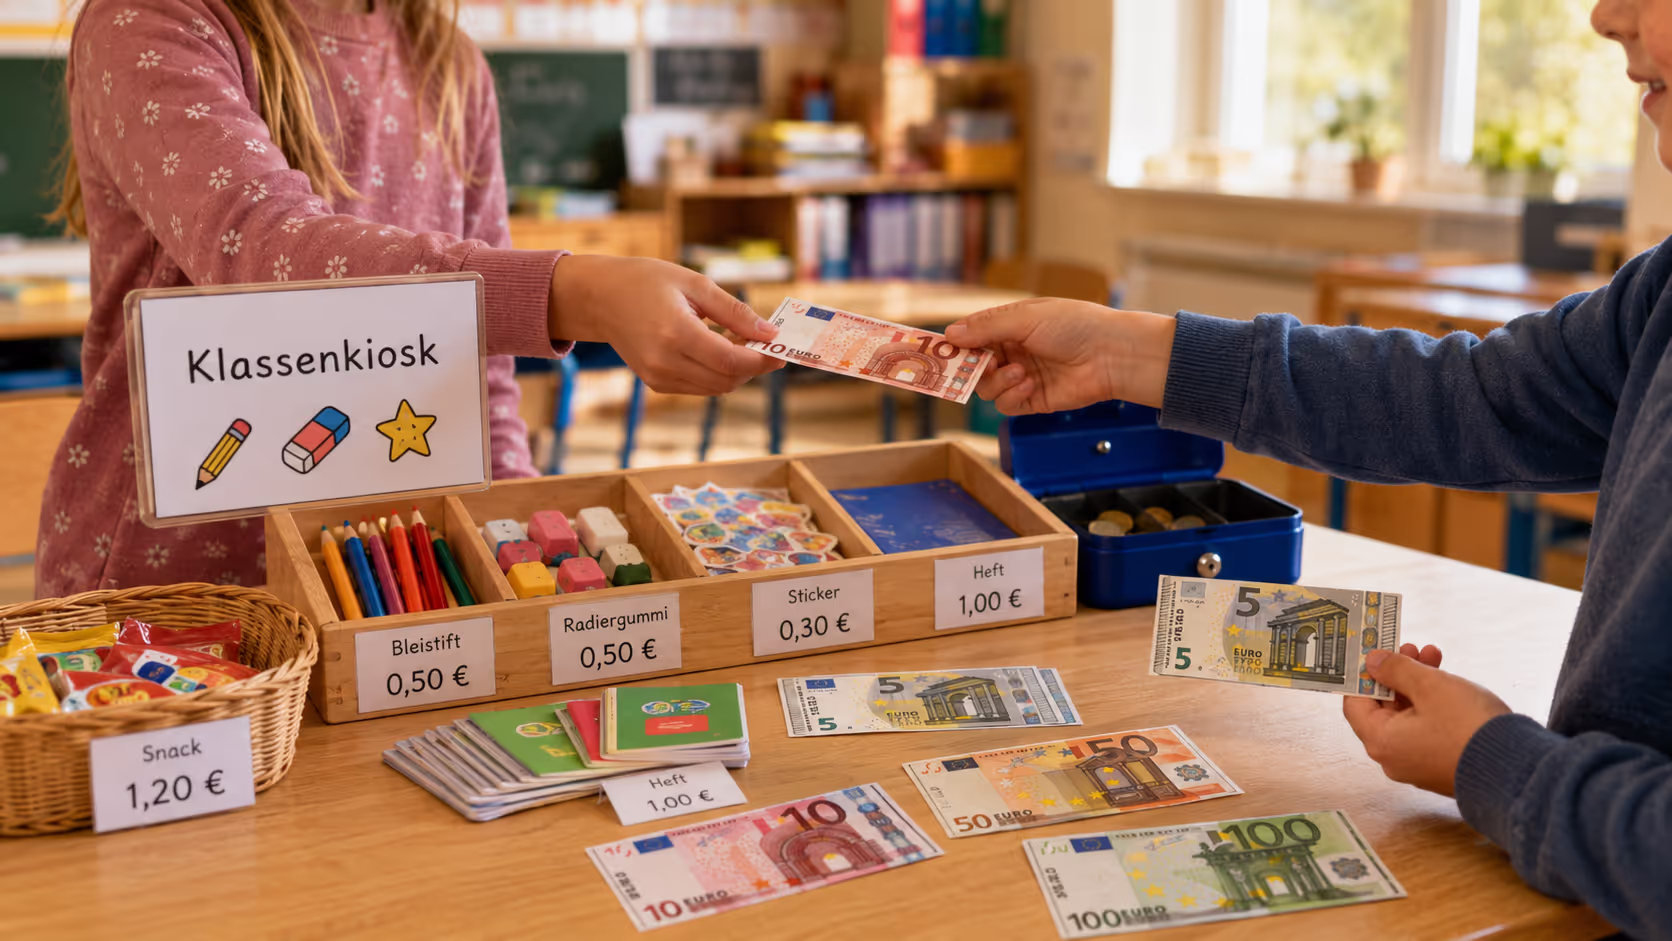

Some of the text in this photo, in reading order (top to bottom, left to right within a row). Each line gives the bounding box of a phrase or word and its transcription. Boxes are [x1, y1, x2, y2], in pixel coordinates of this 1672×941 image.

[187, 333, 439, 383] Klassenkiosk
[916, 335, 960, 360] 10
[973, 563, 1005, 580] Heft
[788, 586, 840, 604] Sticker
[958, 589, 1022, 617] 1,00 €
[1236, 586, 1261, 617] 5
[563, 606, 669, 633] Radiergummi
[779, 612, 851, 643] 0,30 €
[392, 633, 461, 656] Bleistift
[580, 638, 657, 671] 0,50 €
[1234, 648, 1262, 658] EURO
[1174, 647, 1192, 670] 5
[386, 665, 470, 698] 0,50 €
[878, 676, 904, 694] 5
[818, 717, 838, 731] 5
[142, 738, 202, 762] Snack
[1086, 734, 1158, 760] 50
[126, 769, 225, 812] 1,20 €
[649, 774, 688, 789] Heft
[647, 789, 714, 813] 1,00 €
[780, 799, 847, 831] 10
[953, 809, 1033, 832] 50 EURO
[1221, 817, 1321, 850] 100
[643, 900, 682, 921] 10
[1067, 905, 1166, 931] 100 EURO
